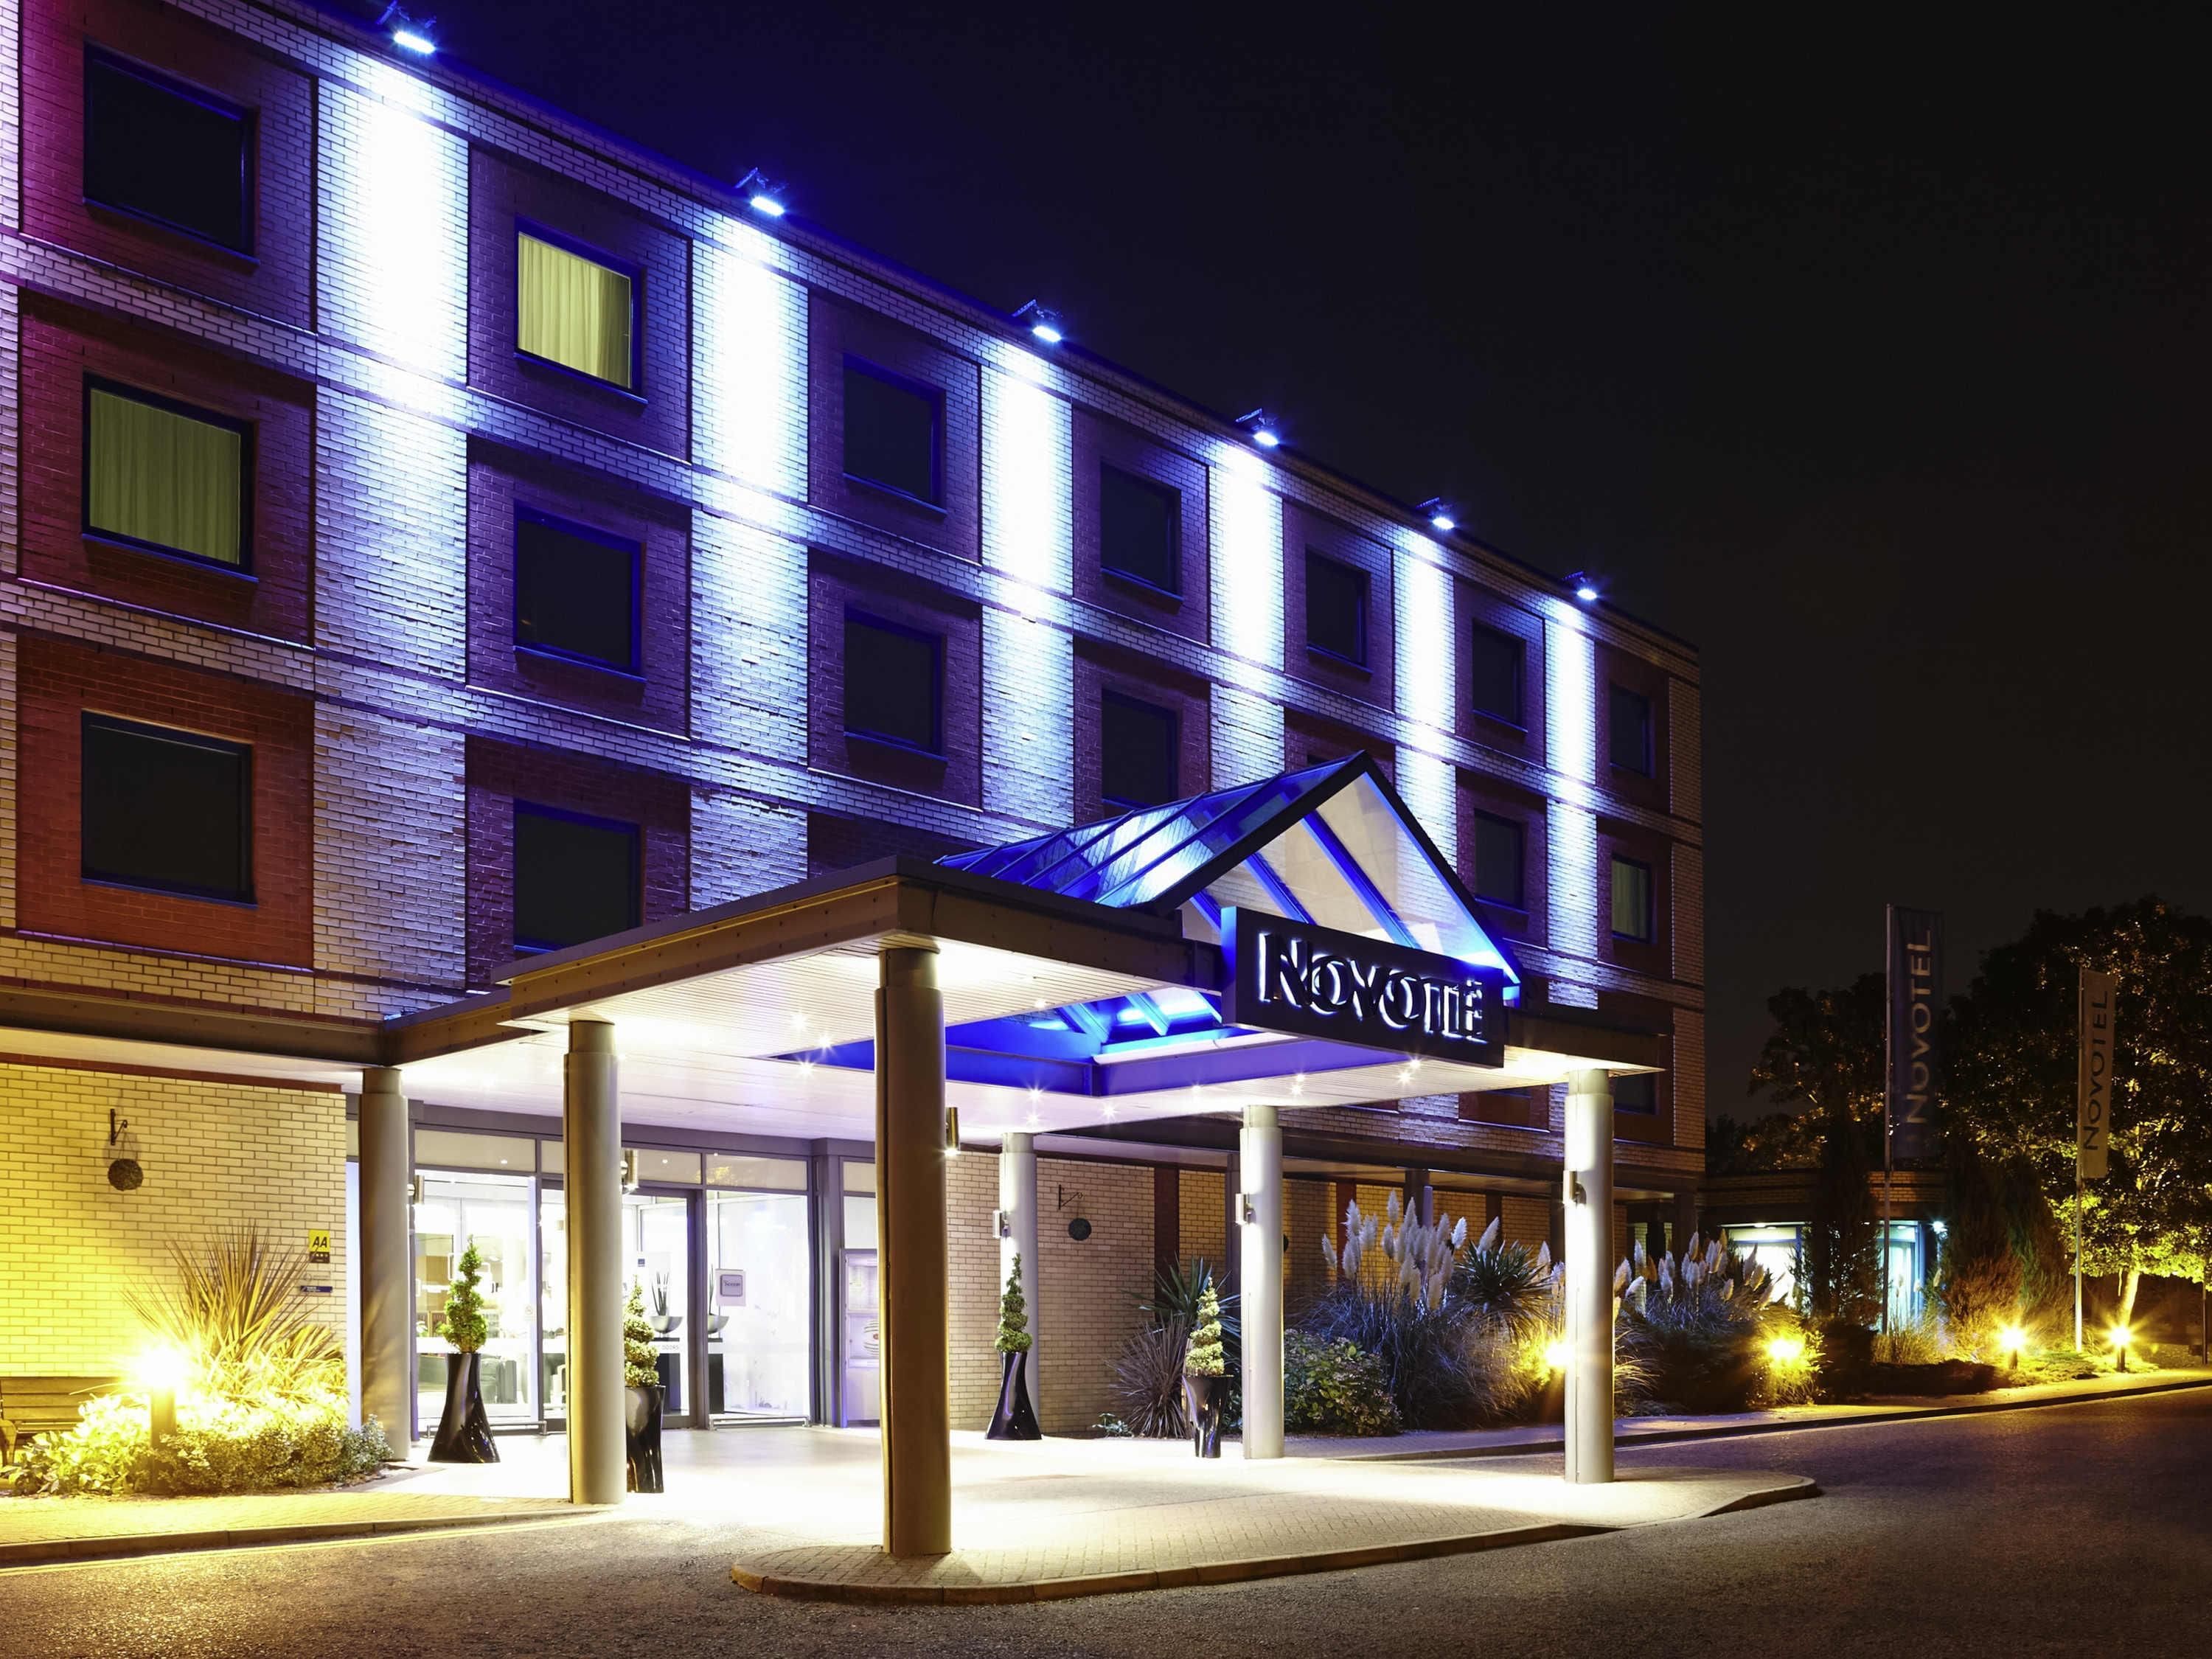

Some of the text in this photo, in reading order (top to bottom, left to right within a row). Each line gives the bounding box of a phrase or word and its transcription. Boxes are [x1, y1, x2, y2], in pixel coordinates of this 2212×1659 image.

[1258, 932, 1488, 1043] NOVOTEL
[1905, 930, 1933, 1124] NOVOTEL
[2082, 990, 2108, 1151] NOVOTEL
[312, 1236, 327, 1248] AA
